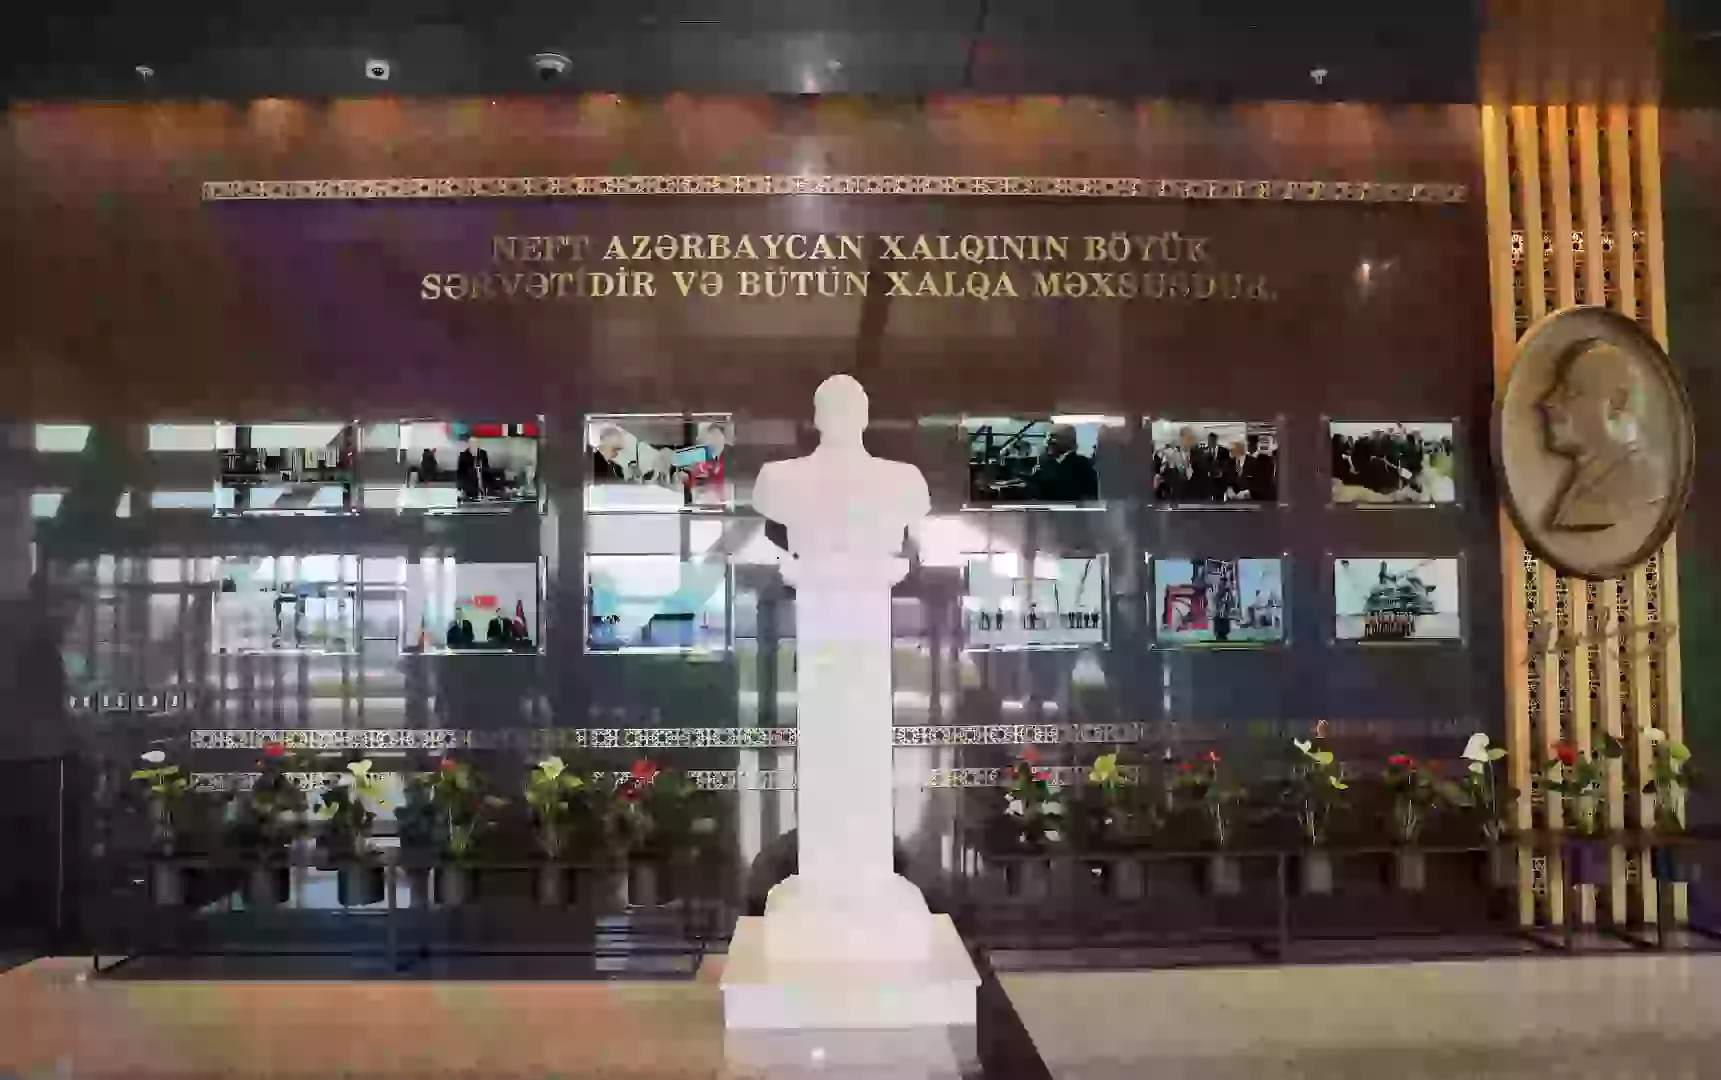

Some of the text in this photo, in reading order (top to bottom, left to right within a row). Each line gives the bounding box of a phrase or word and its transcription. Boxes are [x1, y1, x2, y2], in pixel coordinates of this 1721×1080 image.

[491, 231, 1209, 264] NEFT AZƏRBAYCAN XALQININ BÖYÜK
[672, 271, 724, 297] VƏ
[738, 267, 869, 297] BÜTÜN
[884, 271, 1019, 301] XALQA
